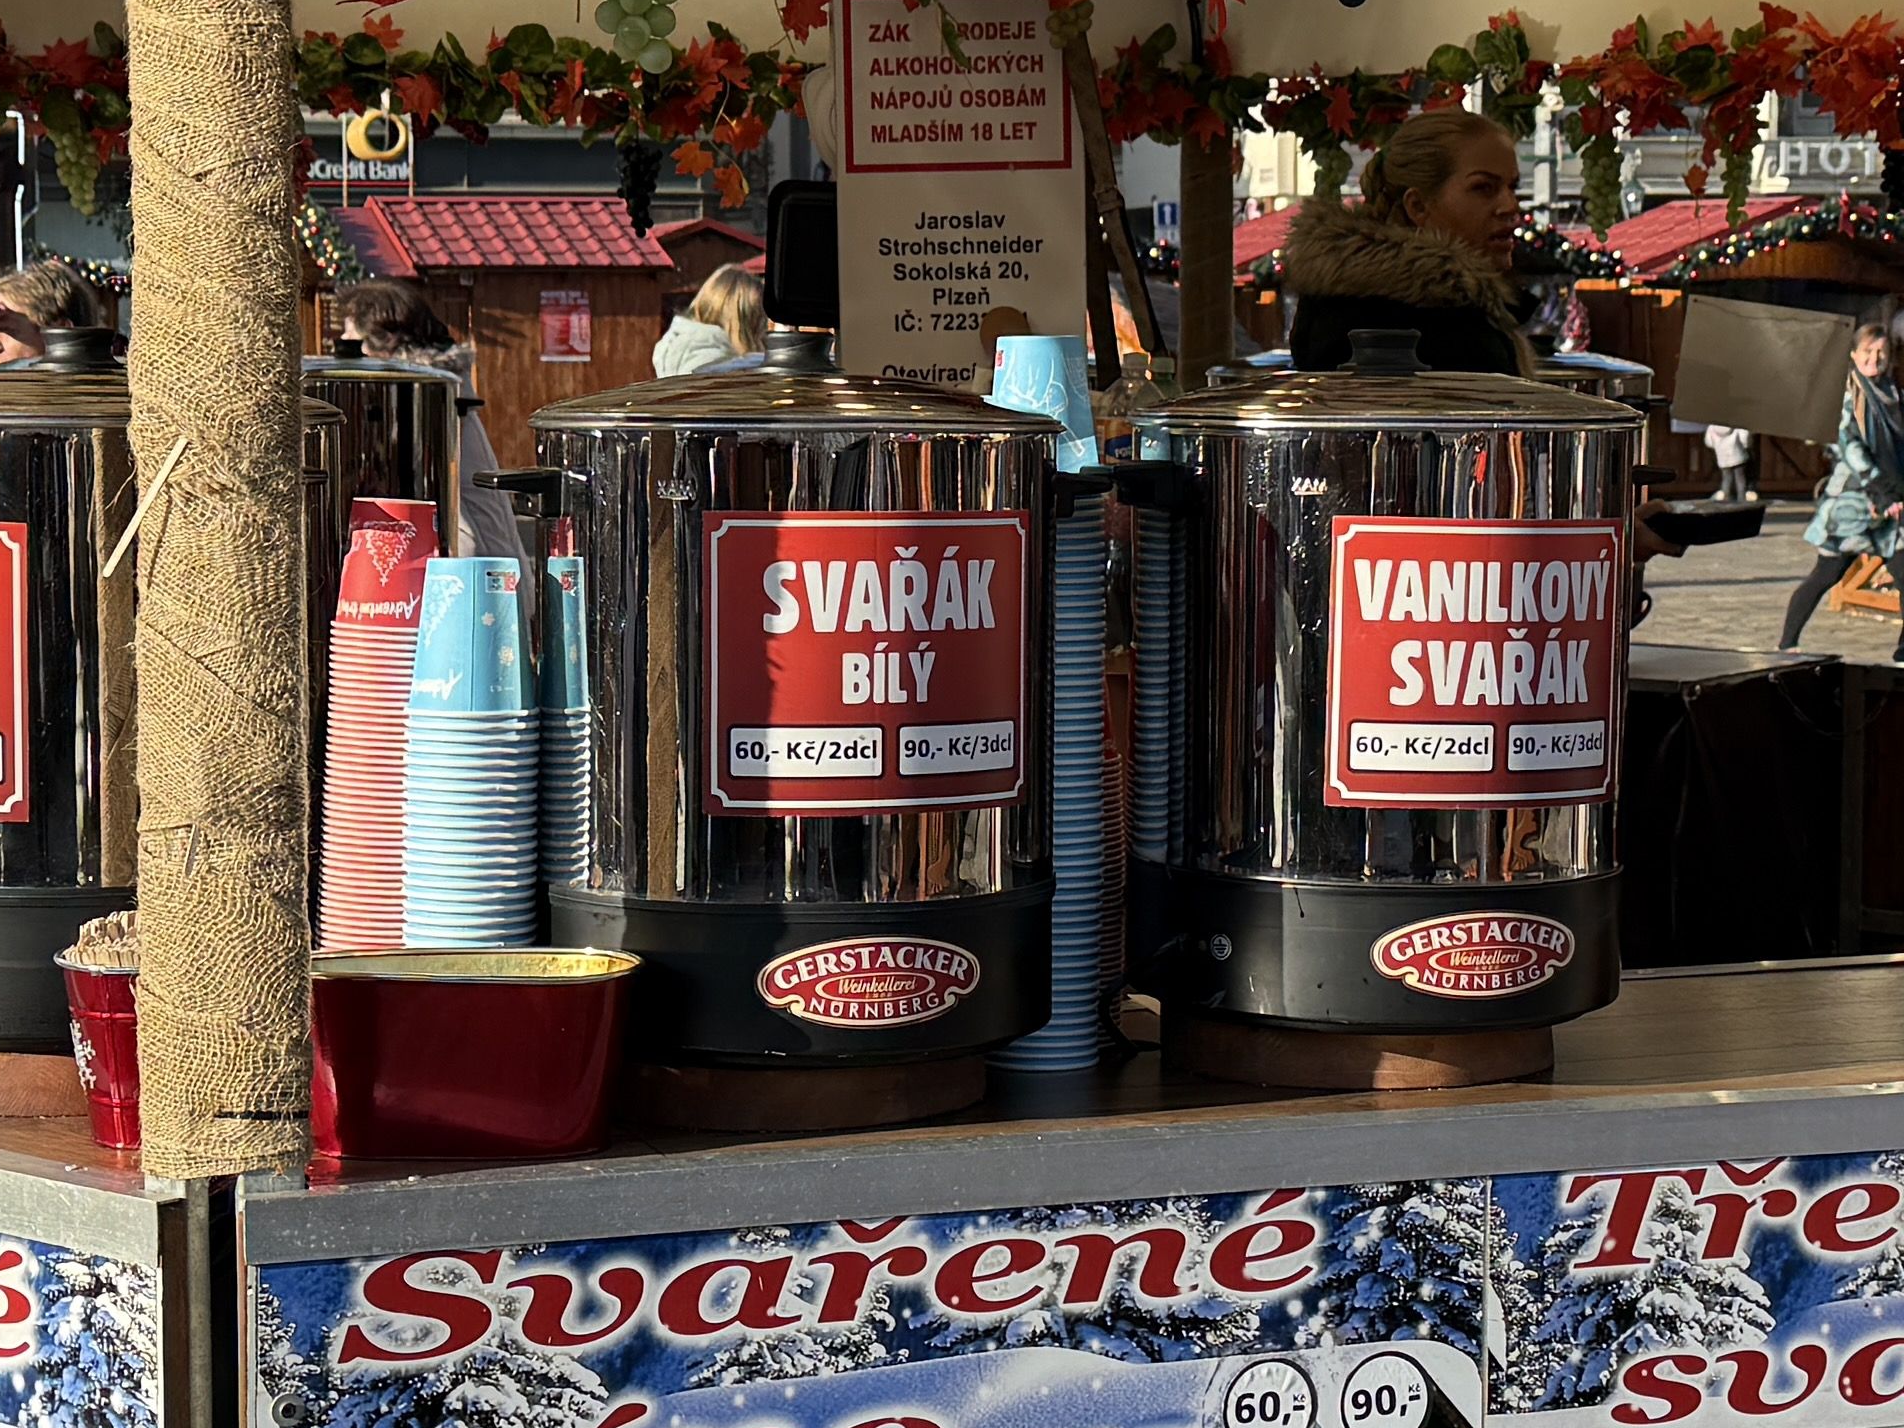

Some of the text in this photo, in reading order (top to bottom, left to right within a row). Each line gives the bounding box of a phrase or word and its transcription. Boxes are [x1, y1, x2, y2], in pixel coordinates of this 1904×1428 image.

[868, 19, 1036, 43] ZÁK RODEJE
[871, 83, 1046, 110] NÁPOJŮ OSOBÁM
[871, 119, 1037, 143] MLADŠÍM 18 LET
[915, 210, 1005, 230] Jaroslav
[878, 235, 1043, 256] Strohschneider
[893, 261, 1029, 281] Sokolská 20,
[933, 287, 990, 306] Plzeň
[894, 309, 922, 332] IČ:
[762, 546, 996, 634] SVAŘÁK
[1353, 549, 1611, 623] VANILKOVÝ
[841, 641, 936, 705] BÍLÝ
[1389, 628, 1589, 706] SVAŘÁK
[735, 732, 1013, 764] 60,- Kč/2dcl 90,- Kč/3dcl
[1355, 729, 1603, 758] 60,- Kč/2dcl 90,- Kč/3dcl
[1389, 921, 1566, 962] GERSTACKER
[773, 946, 969, 990] GERSTACKER
[337, 1187, 1321, 1364] Svařené
